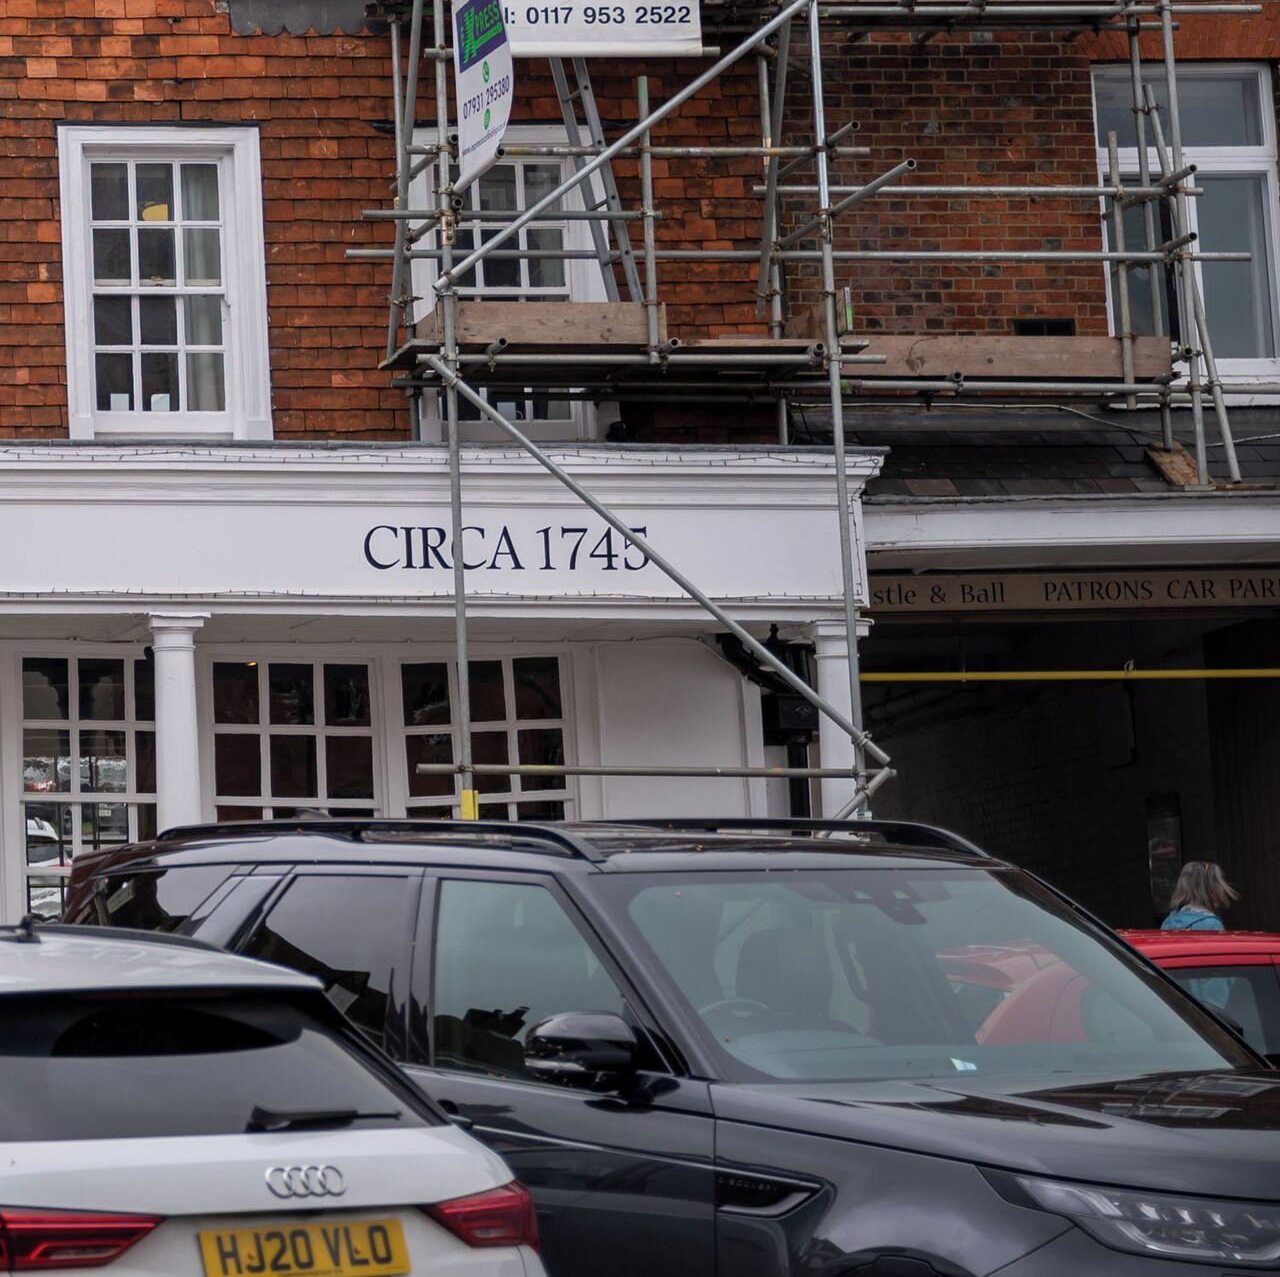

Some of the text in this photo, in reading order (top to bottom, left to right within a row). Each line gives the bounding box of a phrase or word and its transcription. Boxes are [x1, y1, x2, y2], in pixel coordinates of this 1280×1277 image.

[526, 7, 574, 24] 0117
[583, 7, 626, 24] 953
[635, 6, 691, 24] 2522
[463, 92, 484, 120] 07931
[363, 525, 651, 571] CIRCA 1745
[872, 577, 1280, 606] stle & Ball PATRONS CAR PAR
[216, 1225, 393, 1276] HJ20 VLO
